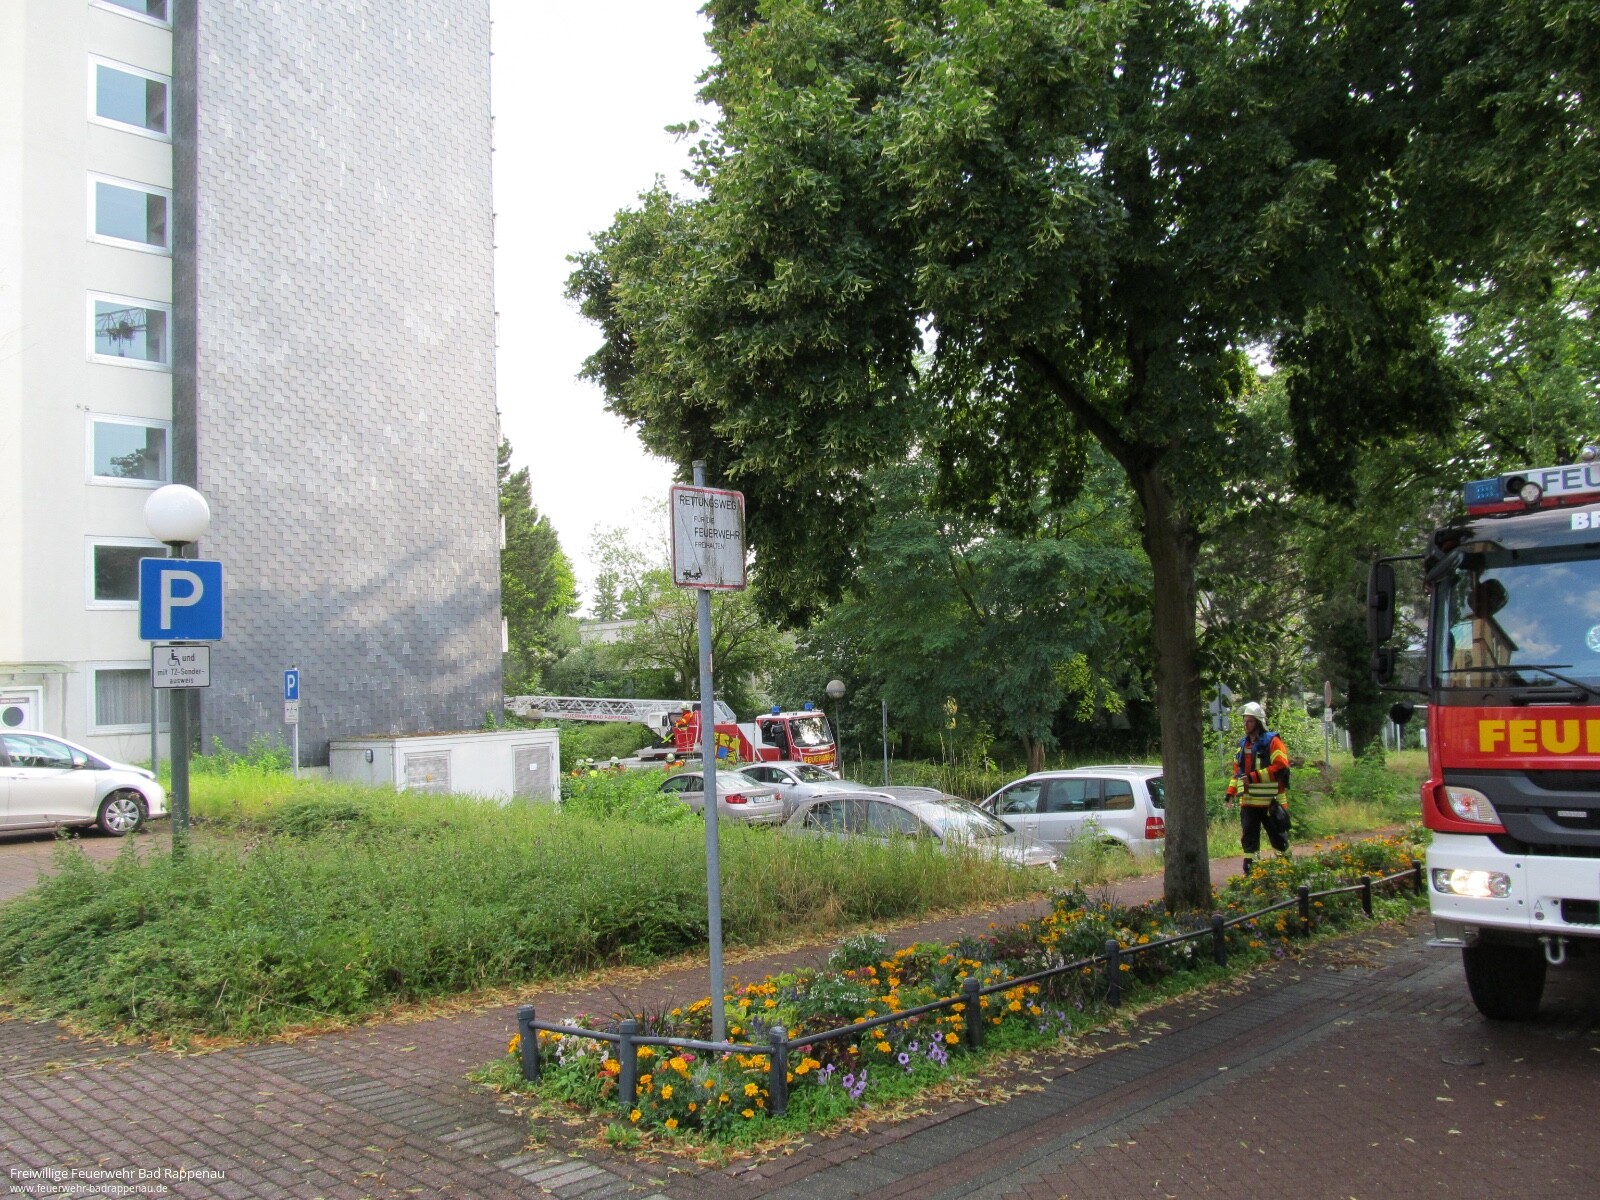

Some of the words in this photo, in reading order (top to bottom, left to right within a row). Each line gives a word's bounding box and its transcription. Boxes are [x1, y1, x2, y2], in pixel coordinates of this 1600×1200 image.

[679, 494, 737, 511] RETTUNGSWEG
[694, 527, 740, 540] FEUERWEHR
[695, 542, 725, 550] FREIHALTEN
[160, 569, 204, 630] P
[181, 653, 195, 662] und
[157, 668, 168, 676] mit
[287, 674, 295, 696] P
